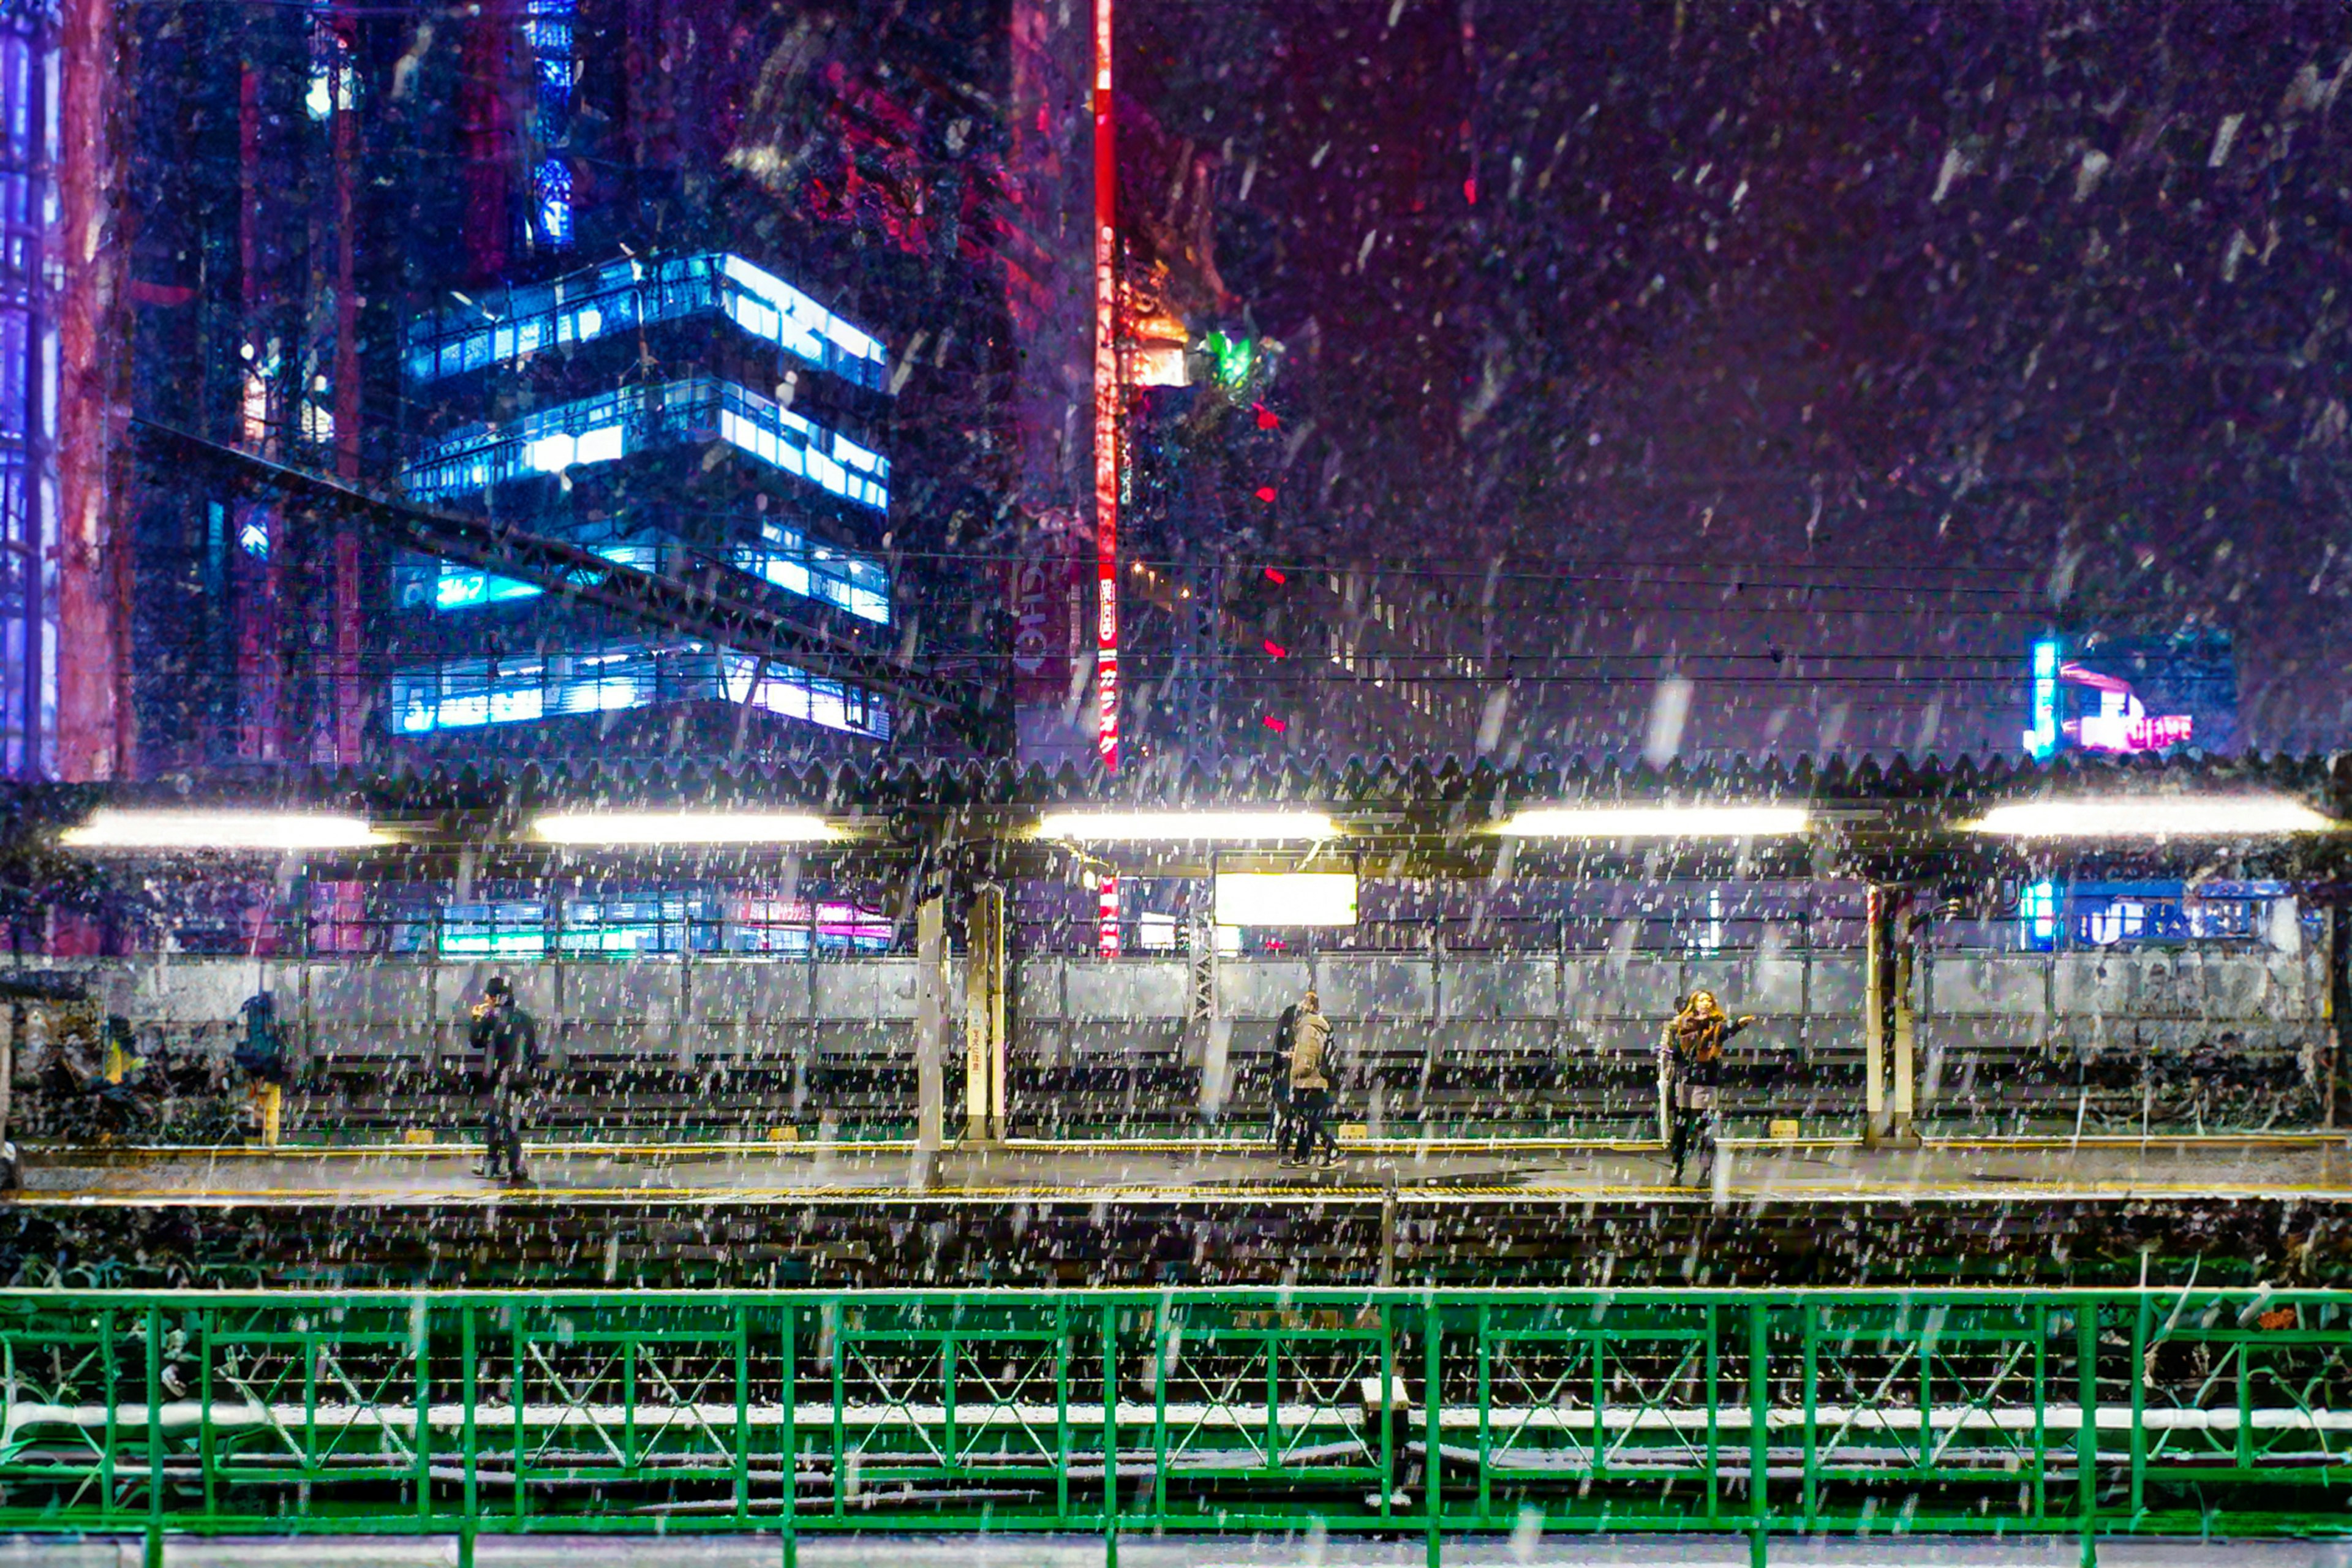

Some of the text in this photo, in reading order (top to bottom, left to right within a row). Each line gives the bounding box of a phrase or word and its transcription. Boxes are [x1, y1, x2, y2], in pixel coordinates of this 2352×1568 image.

[1100, 579, 1113, 641] BIG ECHO
[1099, 669, 1118, 754] カラオケ
